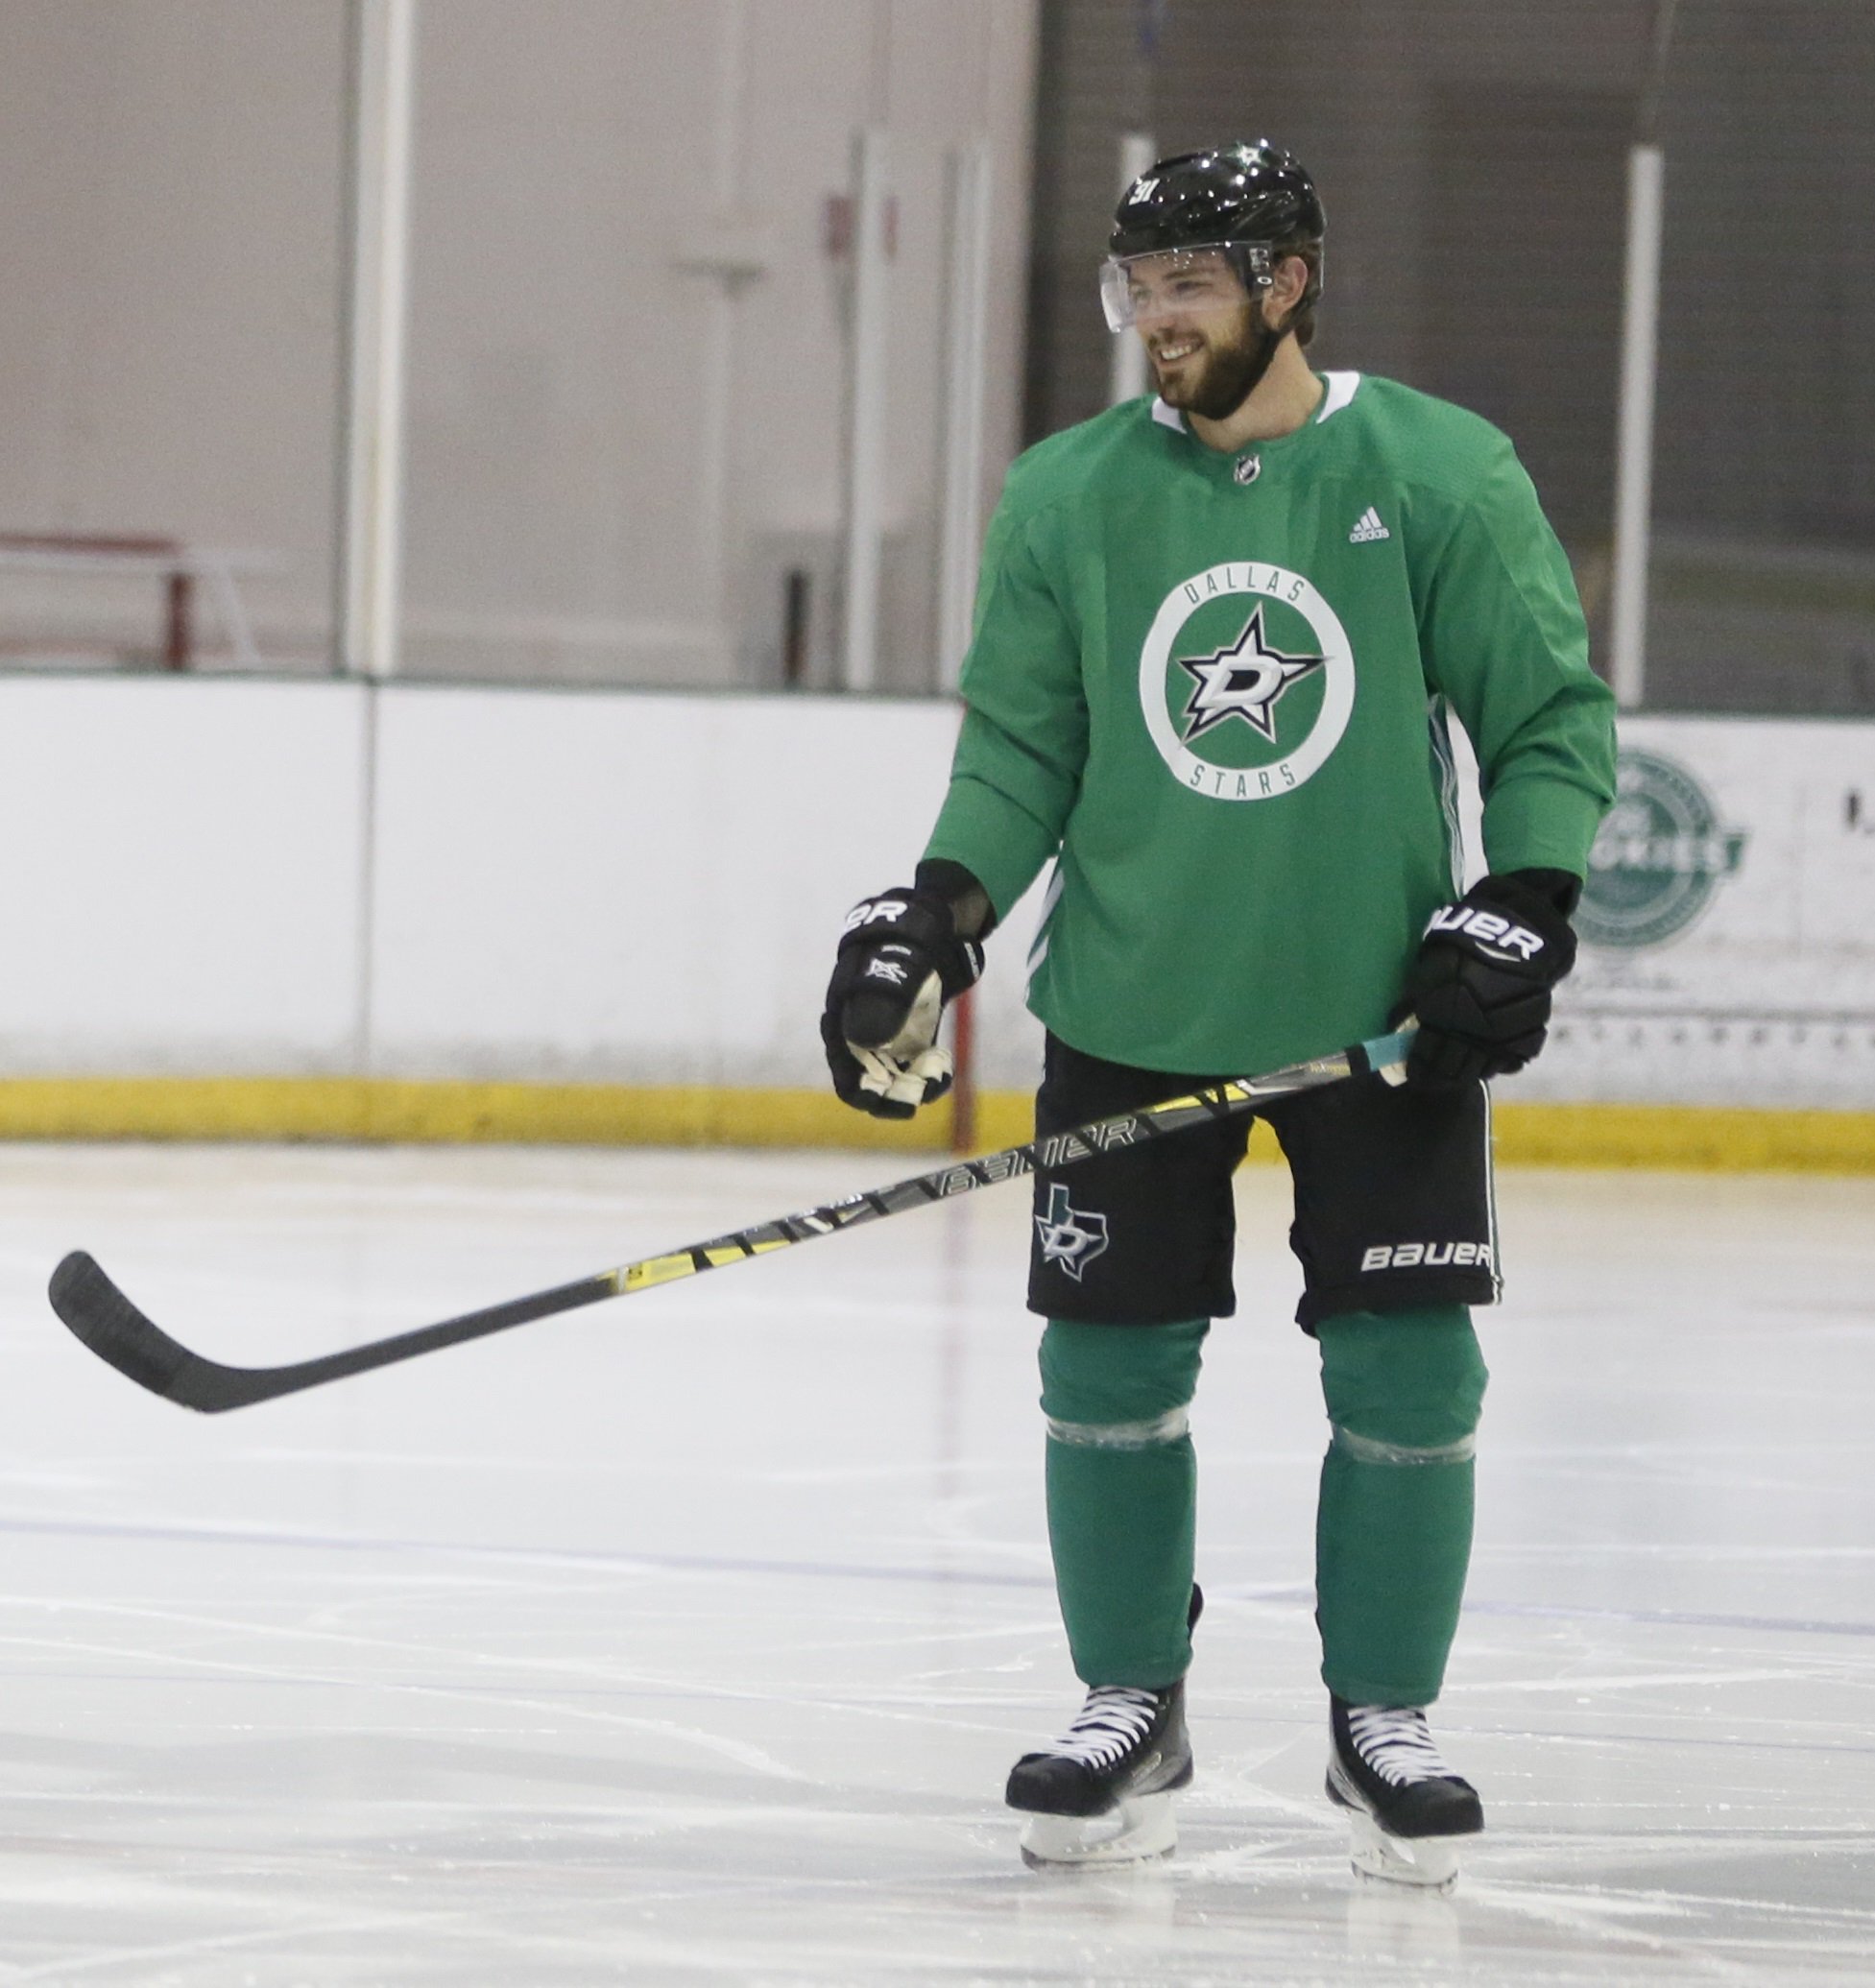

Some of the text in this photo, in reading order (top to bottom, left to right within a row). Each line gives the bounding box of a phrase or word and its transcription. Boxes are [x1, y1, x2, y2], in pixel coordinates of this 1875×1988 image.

[1128, 178, 1161, 205] 91
[1349, 527, 1390, 543] adidas
[1183, 564, 1306, 605] DALLAS
[1190, 764, 1297, 798] STARS
